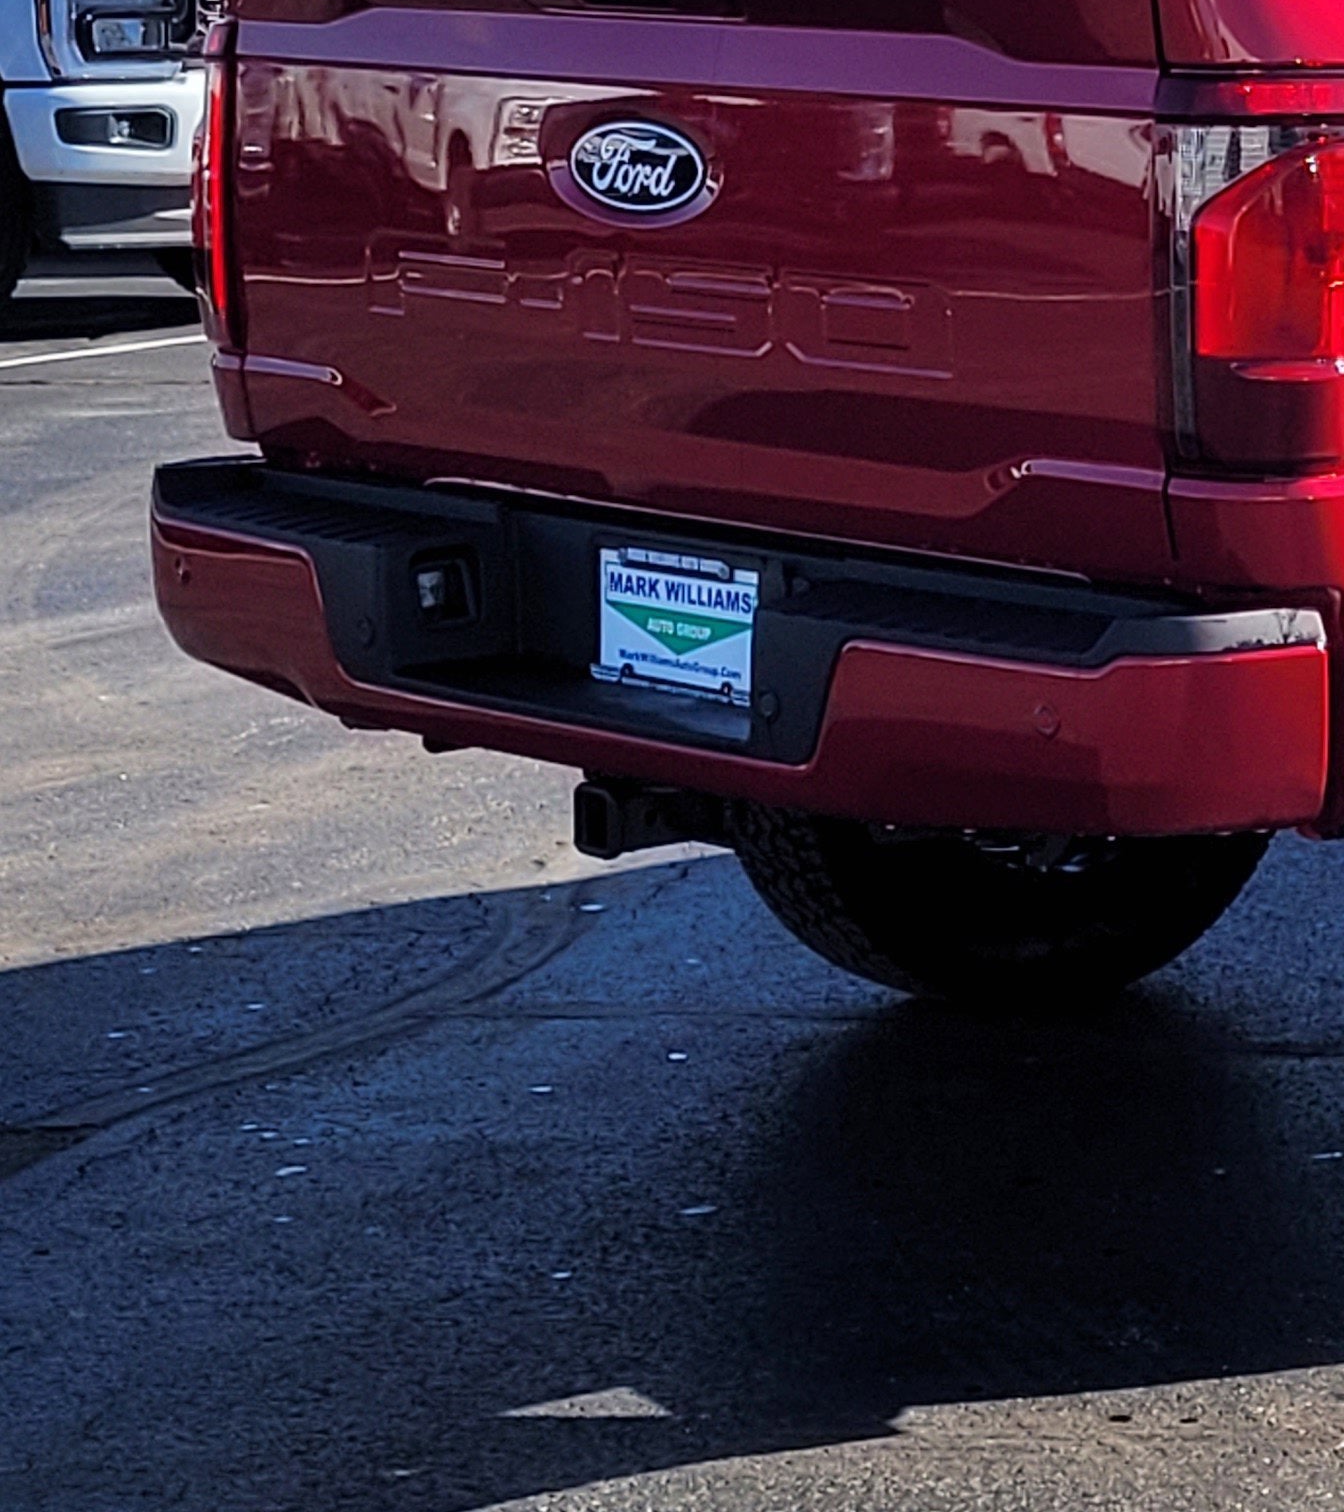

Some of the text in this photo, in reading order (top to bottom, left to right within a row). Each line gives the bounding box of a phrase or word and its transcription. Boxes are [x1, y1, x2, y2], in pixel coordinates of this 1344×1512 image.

[592, 132, 678, 198] Ford
[609, 571, 751, 615] MARK WILLIAMS
[647, 617, 712, 641] AUTO GROUP
